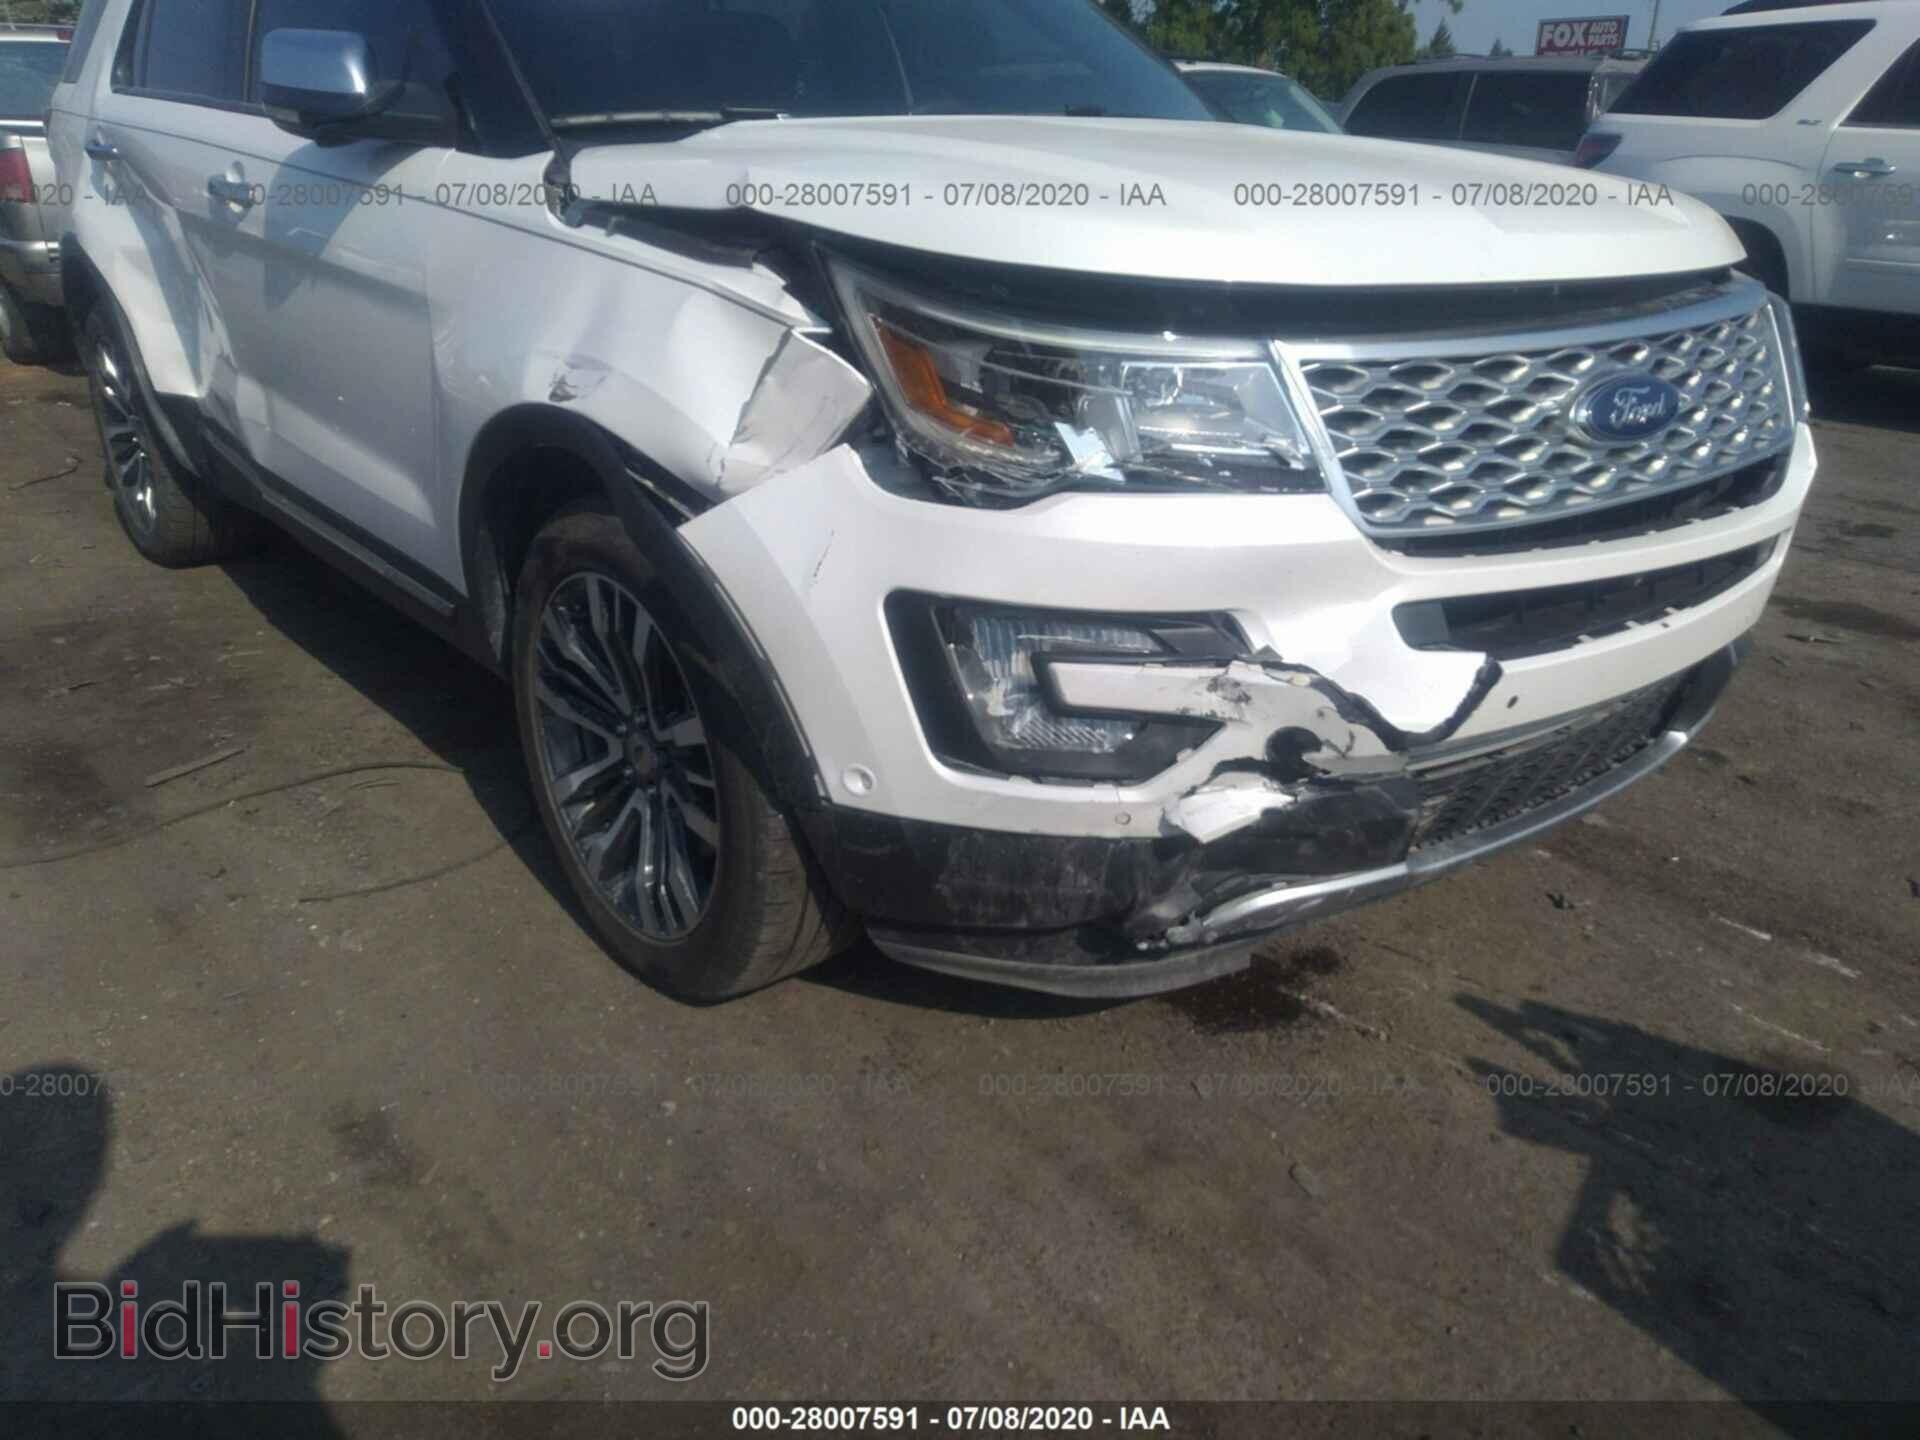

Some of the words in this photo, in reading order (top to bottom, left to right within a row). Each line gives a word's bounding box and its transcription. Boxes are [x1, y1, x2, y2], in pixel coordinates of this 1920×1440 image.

[1540, 23, 1588, 48] FOX
[1590, 21, 1617, 33] AUTO
[1587, 34, 1619, 47] PARTS
[1609, 386, 1665, 426] Ford
